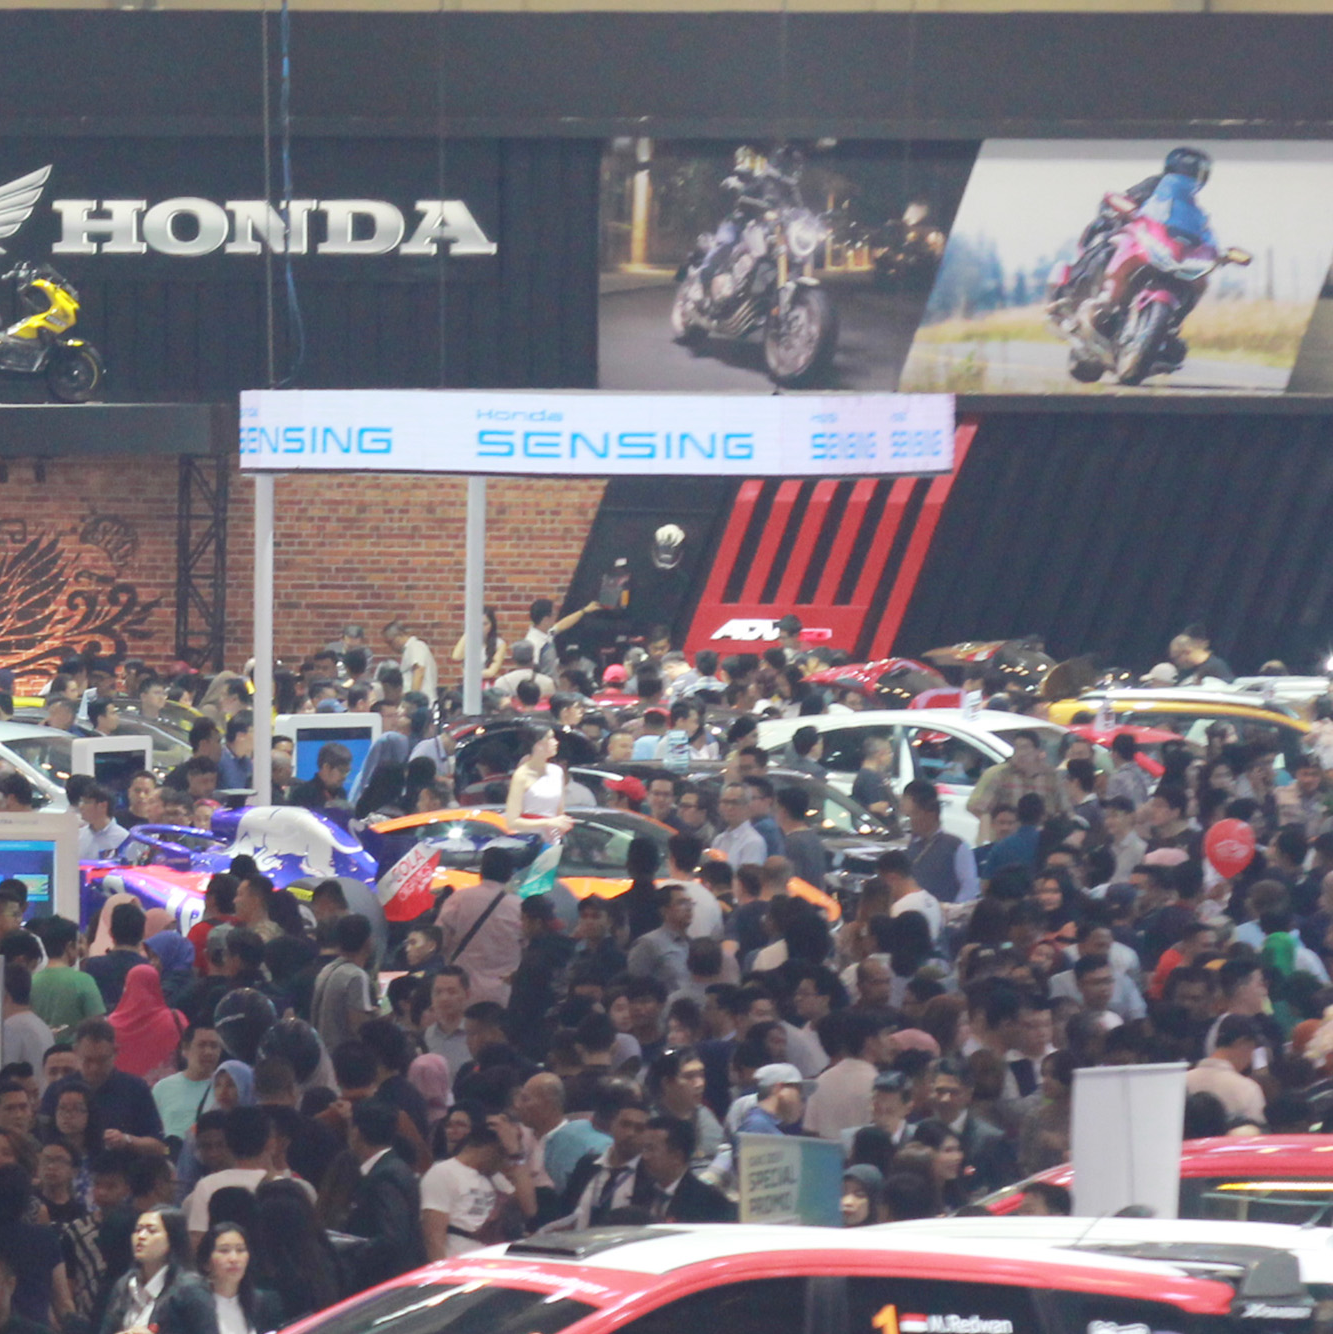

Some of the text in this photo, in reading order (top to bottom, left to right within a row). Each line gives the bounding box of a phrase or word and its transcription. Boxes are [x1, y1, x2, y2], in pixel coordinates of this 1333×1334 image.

[50, 197, 497, 256] HONDA
[476, 408, 564, 422] Honda
[476, 429, 755, 460] SENSING
